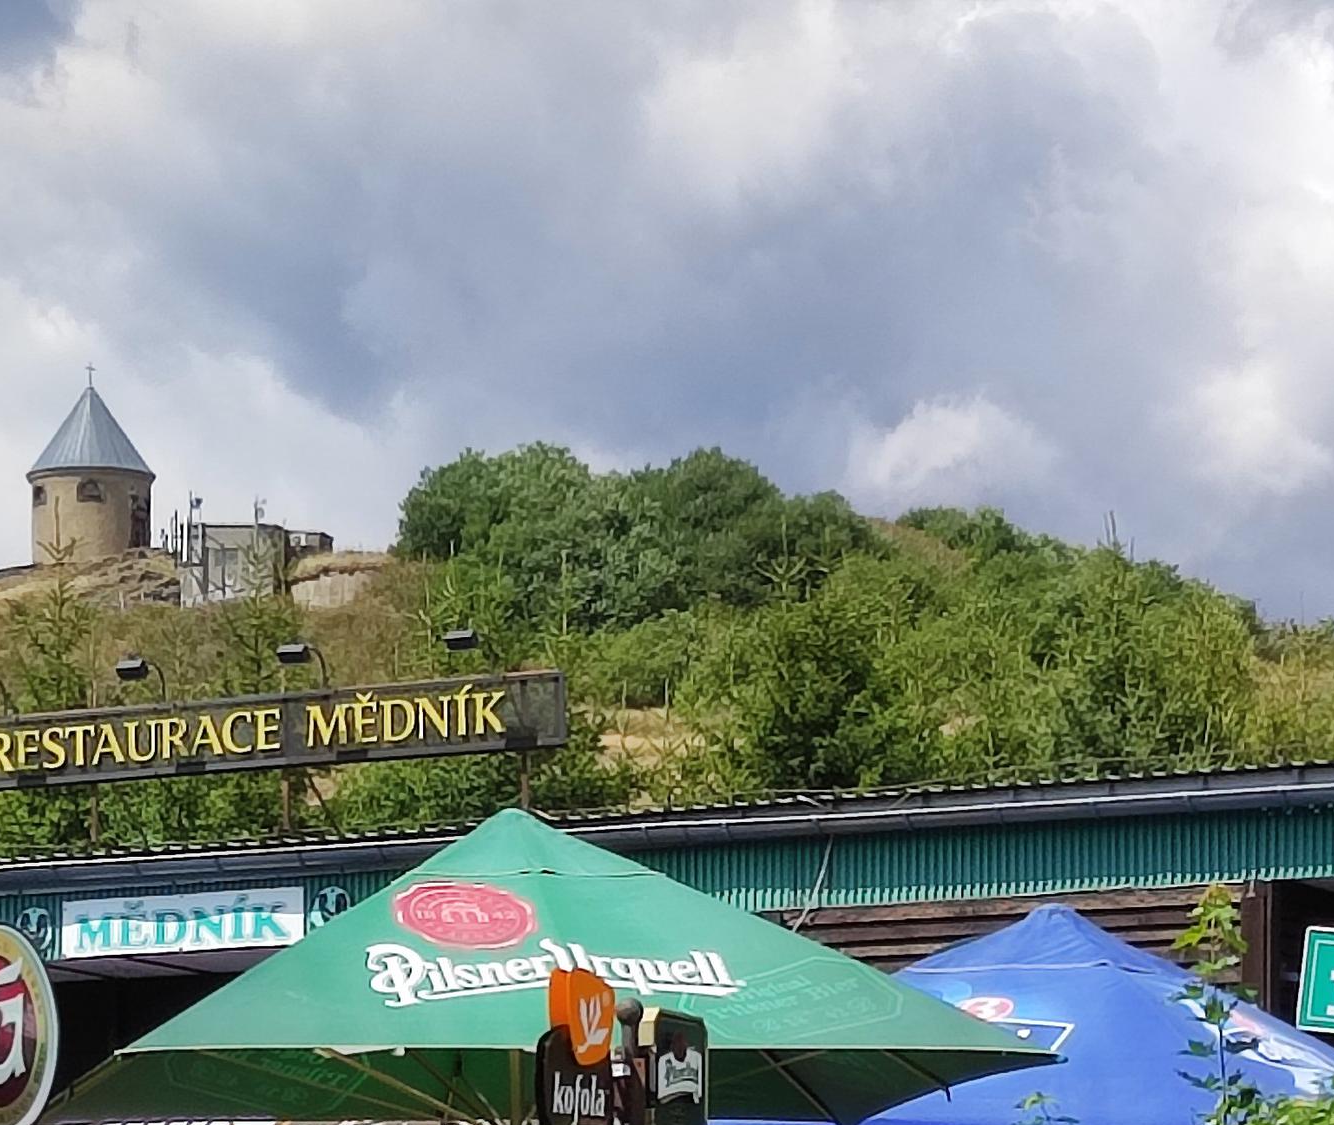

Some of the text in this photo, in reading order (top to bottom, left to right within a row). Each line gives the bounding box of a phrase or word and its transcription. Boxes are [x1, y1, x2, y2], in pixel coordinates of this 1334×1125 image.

[305, 684, 506, 747] MĚDNÍK
[75, 894, 289, 951] MĚDNÍK
[366, 938, 745, 1007] Pilsner Urquell
